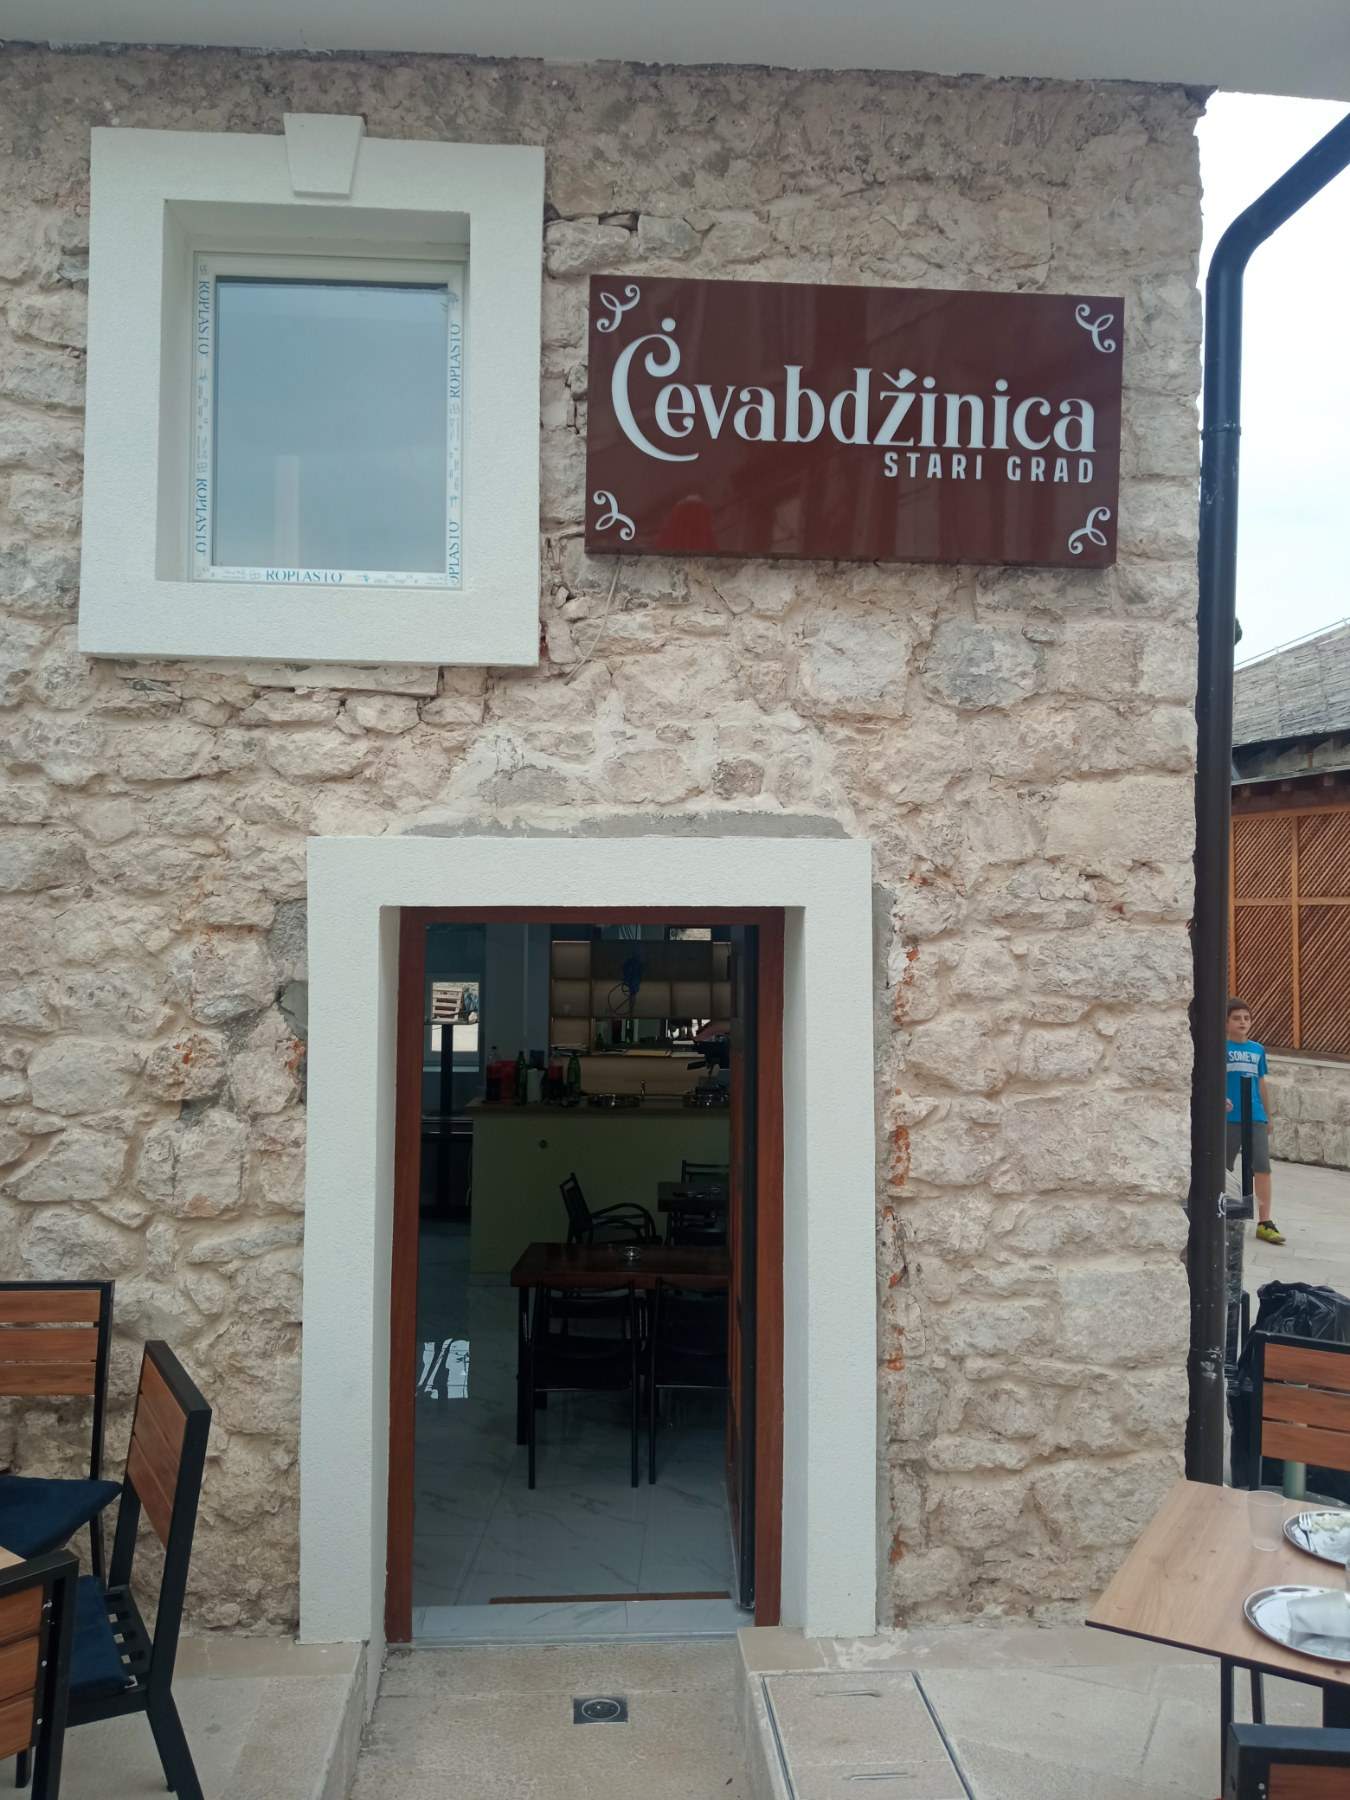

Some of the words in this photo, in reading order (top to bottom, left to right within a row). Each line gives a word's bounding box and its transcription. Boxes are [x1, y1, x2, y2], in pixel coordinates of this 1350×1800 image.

[198, 281, 210, 355] ROPLASTO
[449, 323, 461, 399] ROPLASTO
[883, 452, 983, 480] STARI
[1006, 457, 1094, 484] GRAD
[196, 478, 208, 553] ROPLASTO
[266, 569, 343, 583] ROPLASTO
